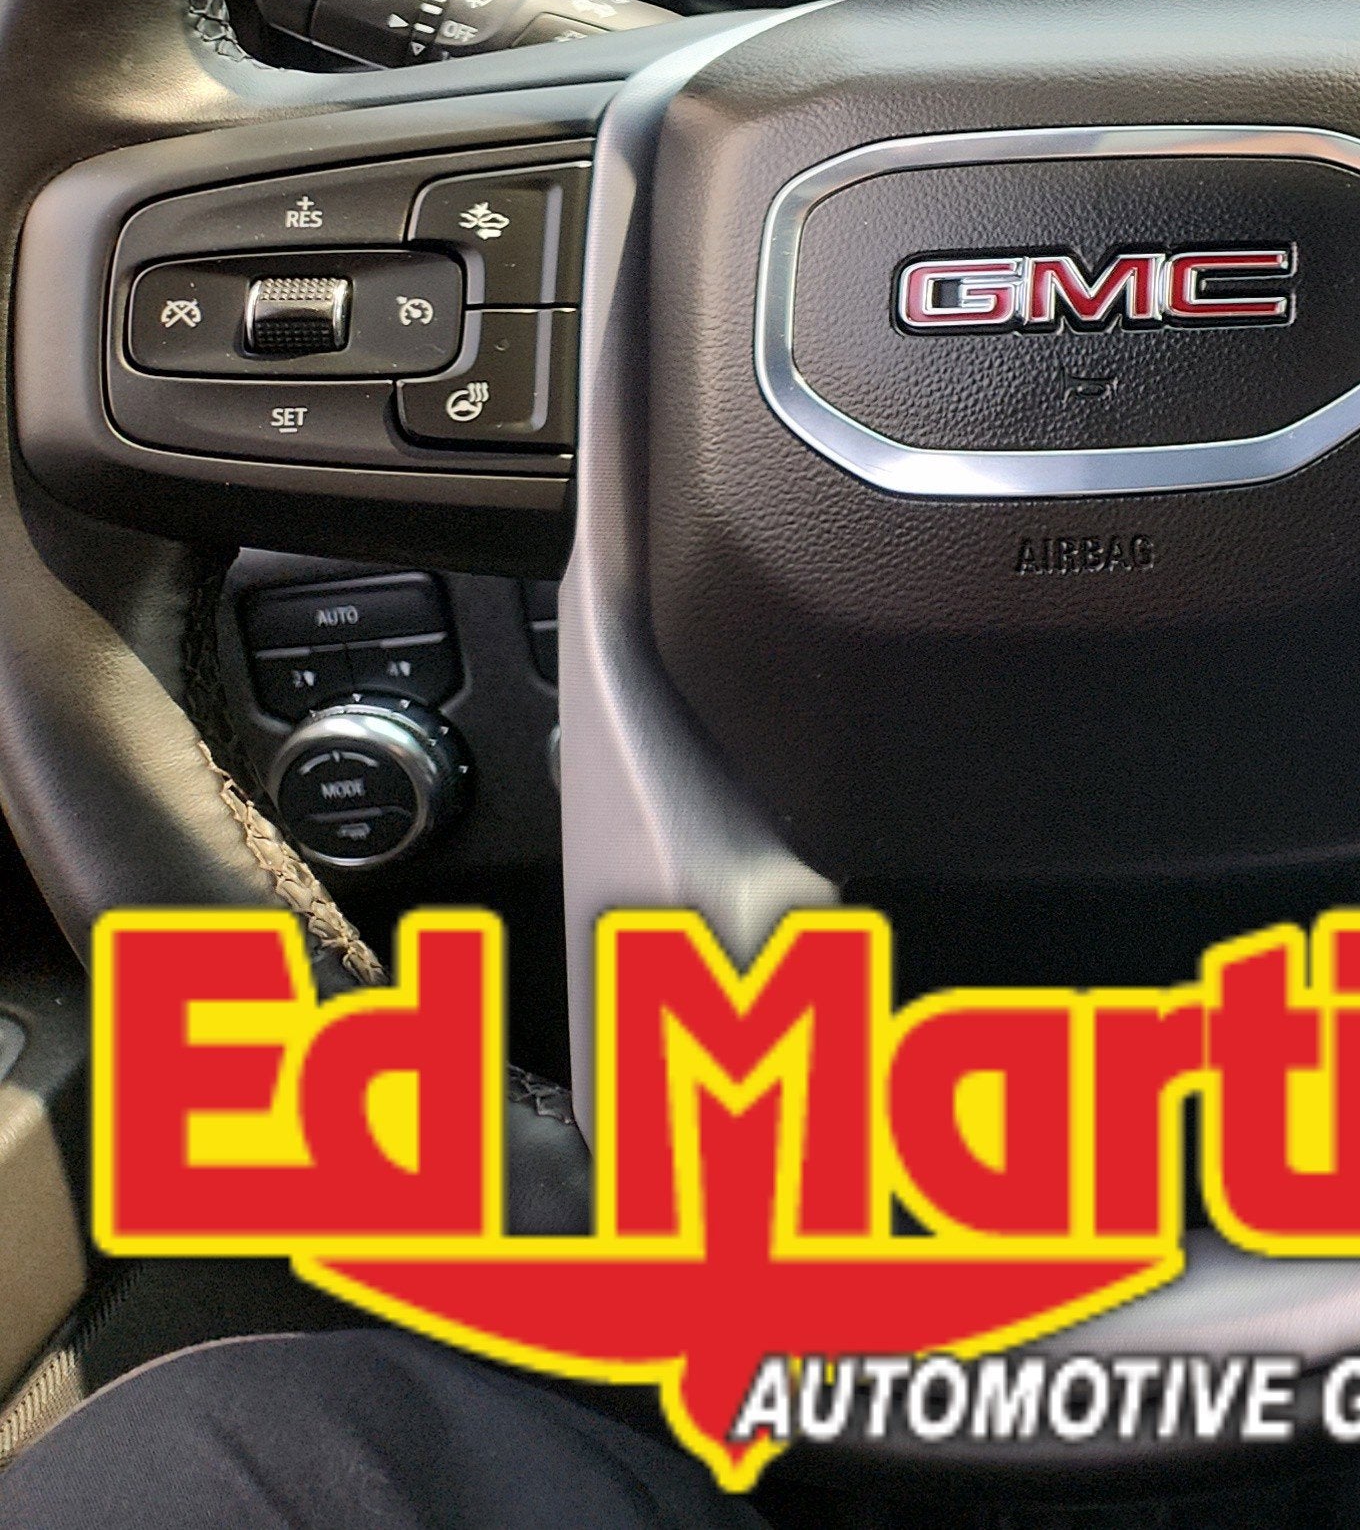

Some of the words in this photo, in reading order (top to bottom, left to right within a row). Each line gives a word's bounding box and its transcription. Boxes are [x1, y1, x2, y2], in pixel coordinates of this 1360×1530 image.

[441, 19, 479, 42] OFF
[285, 210, 323, 229] RES
[899, 249, 1297, 328] GMC
[271, 407, 307, 427] SET
[1015, 533, 1156, 576] AIRBAG
[316, 605, 359, 627] AUTO
[321, 776, 366, 800] MODE
